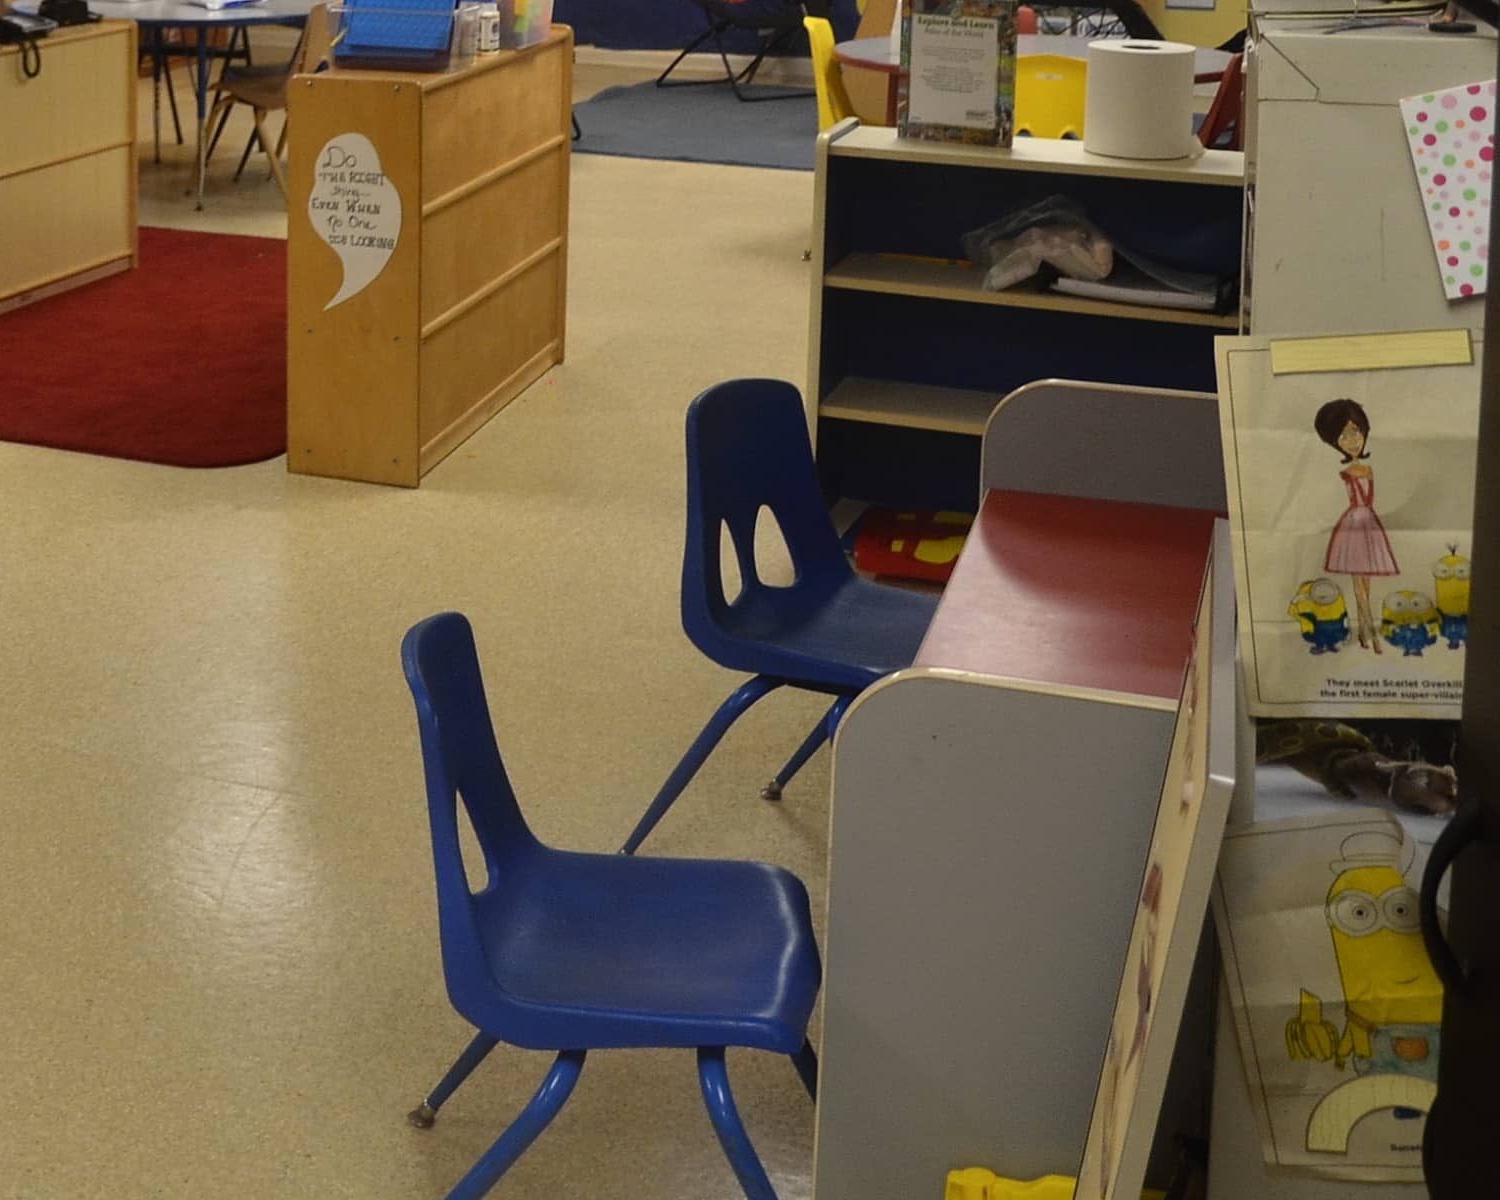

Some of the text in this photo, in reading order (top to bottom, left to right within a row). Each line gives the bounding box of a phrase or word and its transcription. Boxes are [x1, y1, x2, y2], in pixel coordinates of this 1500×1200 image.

[322, 145, 357, 169] Do
[1326, 678, 1350, 688] They
[1353, 679, 1379, 688] meet
[1383, 679, 1418, 689] Scarlet
[1320, 689, 1336, 698] the
[1340, 690, 1360, 698] first
[1363, 690, 1397, 699] female
